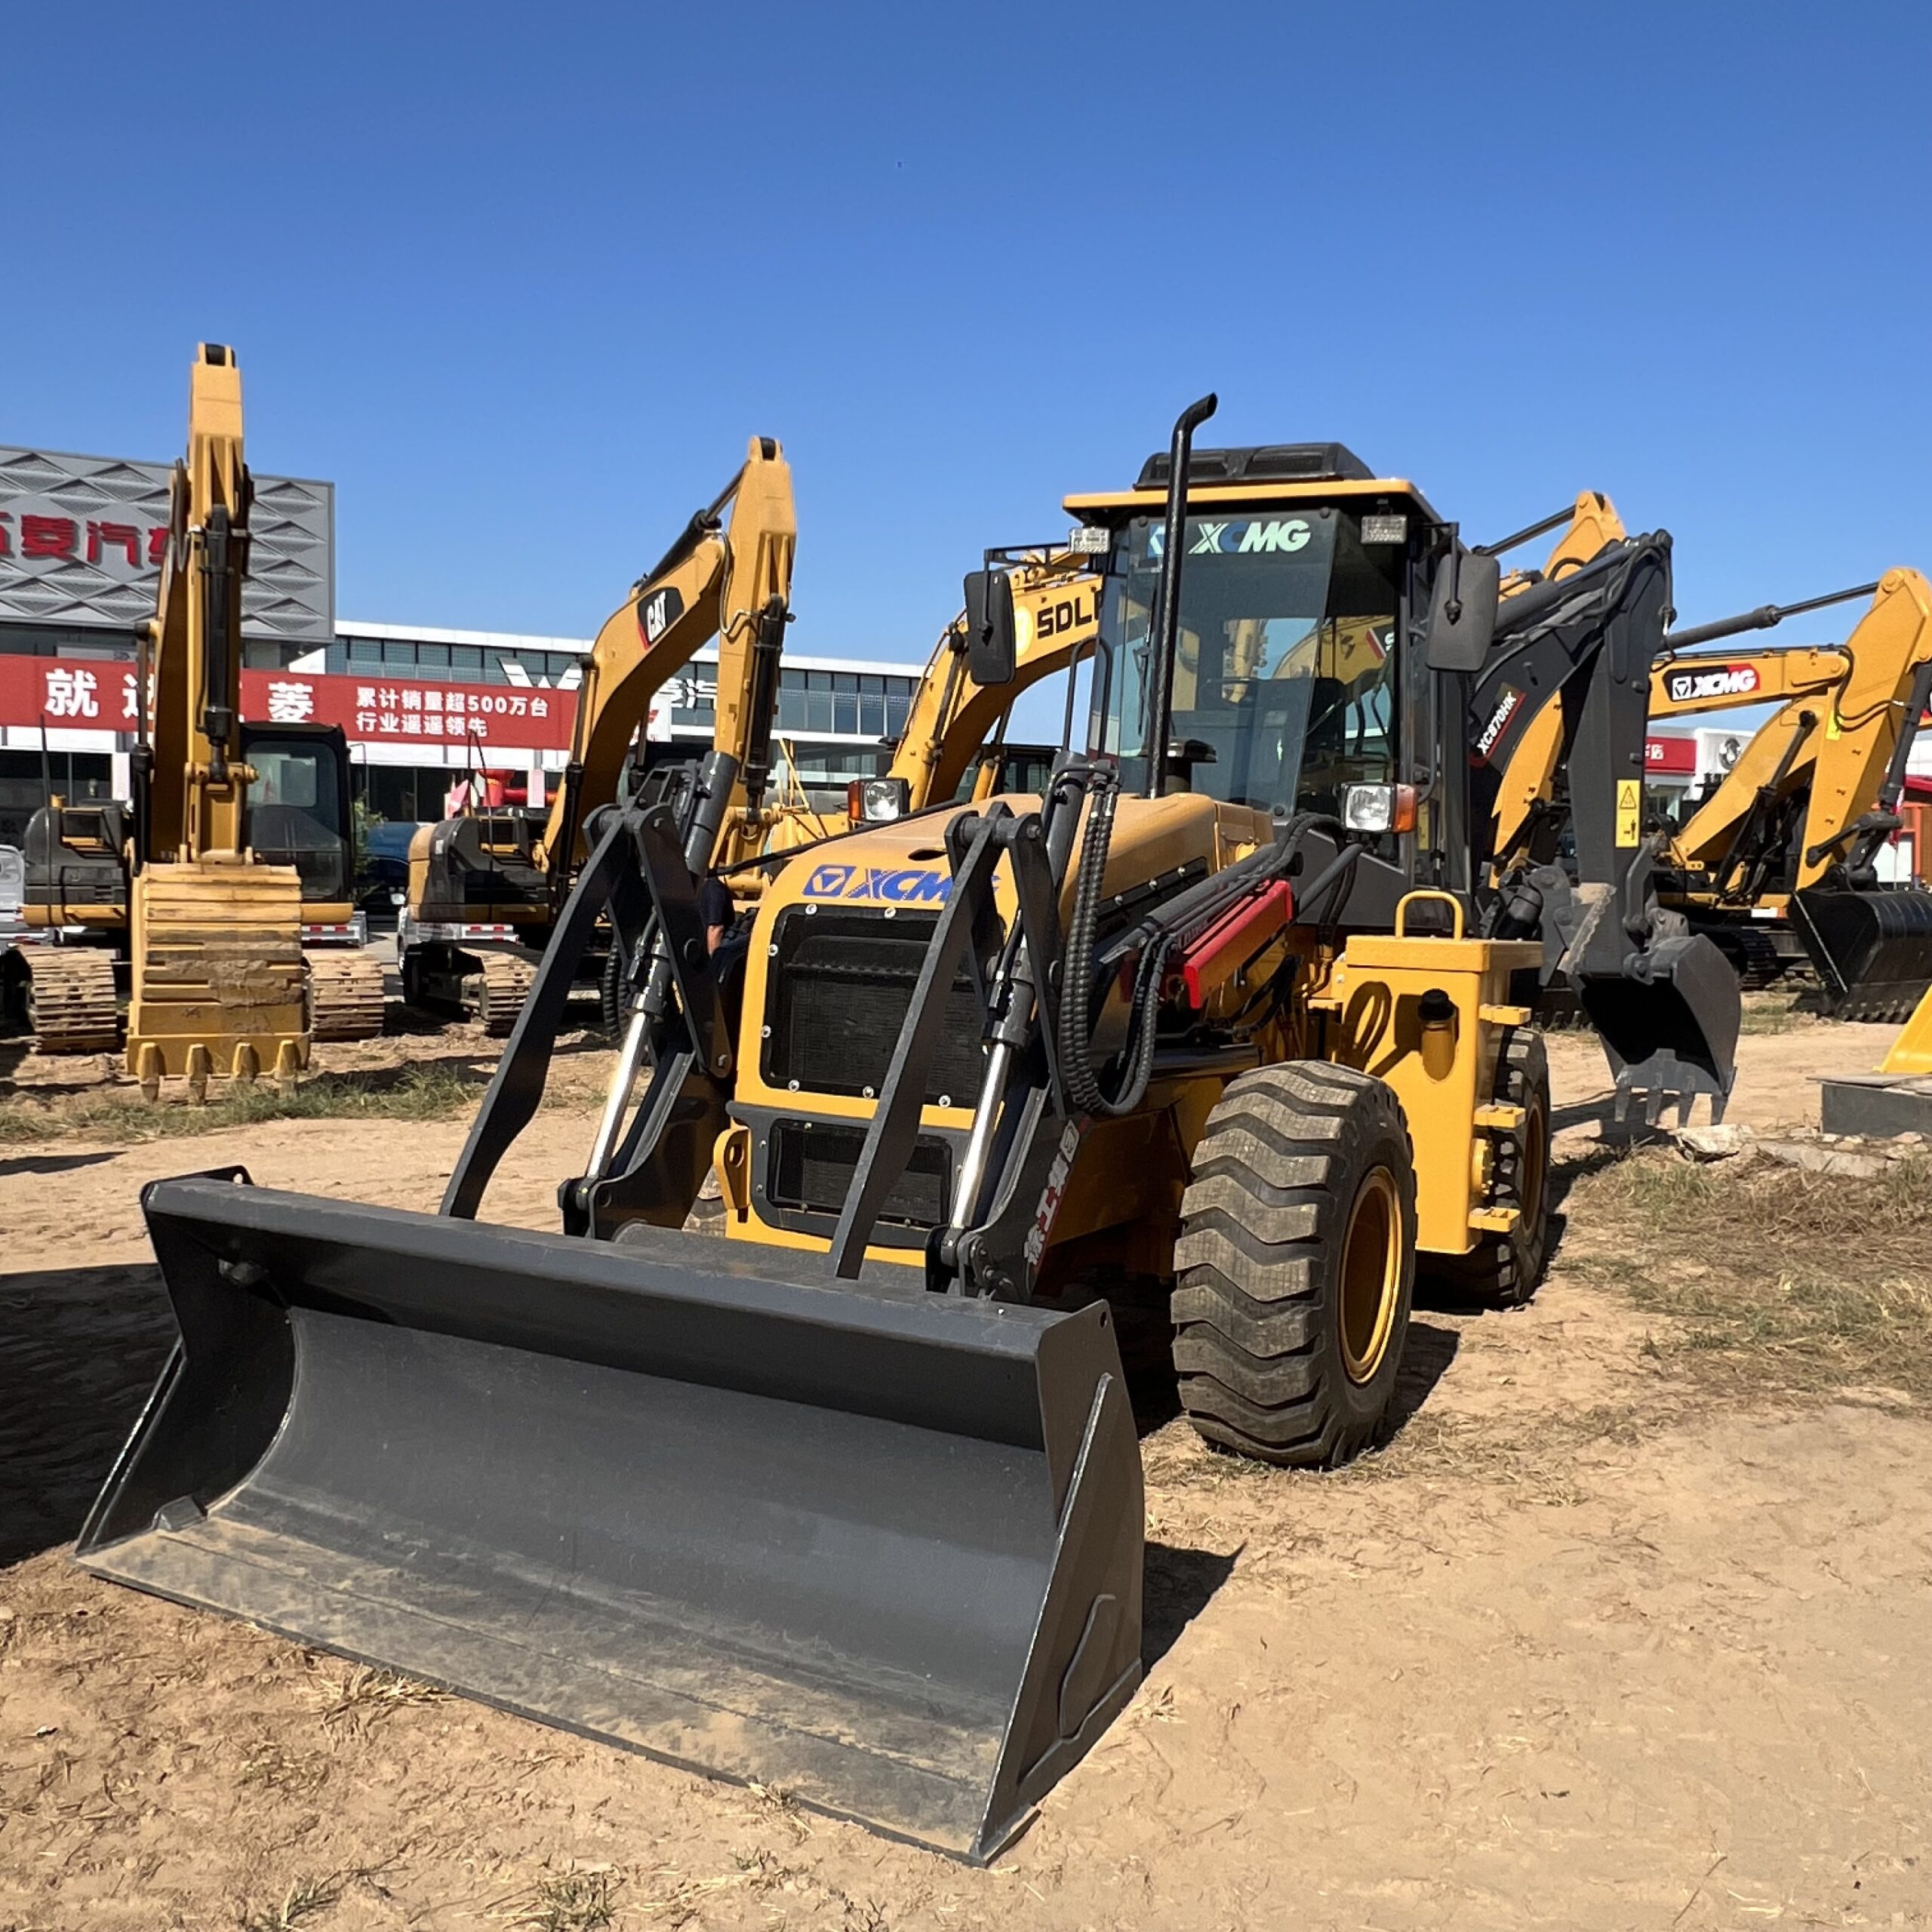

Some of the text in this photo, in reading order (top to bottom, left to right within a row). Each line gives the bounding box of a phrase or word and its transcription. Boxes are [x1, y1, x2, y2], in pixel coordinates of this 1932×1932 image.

[0, 512, 171, 568] 菱汽
[1189, 519, 1311, 555] XCMG
[647, 590, 666, 641] CAT
[1691, 669, 1756, 697] XCMG
[356, 687, 549, 718] 累计销量超500万台
[355, 711, 488, 737] 行业遥遥领先
[844, 868, 1000, 903] XCM
